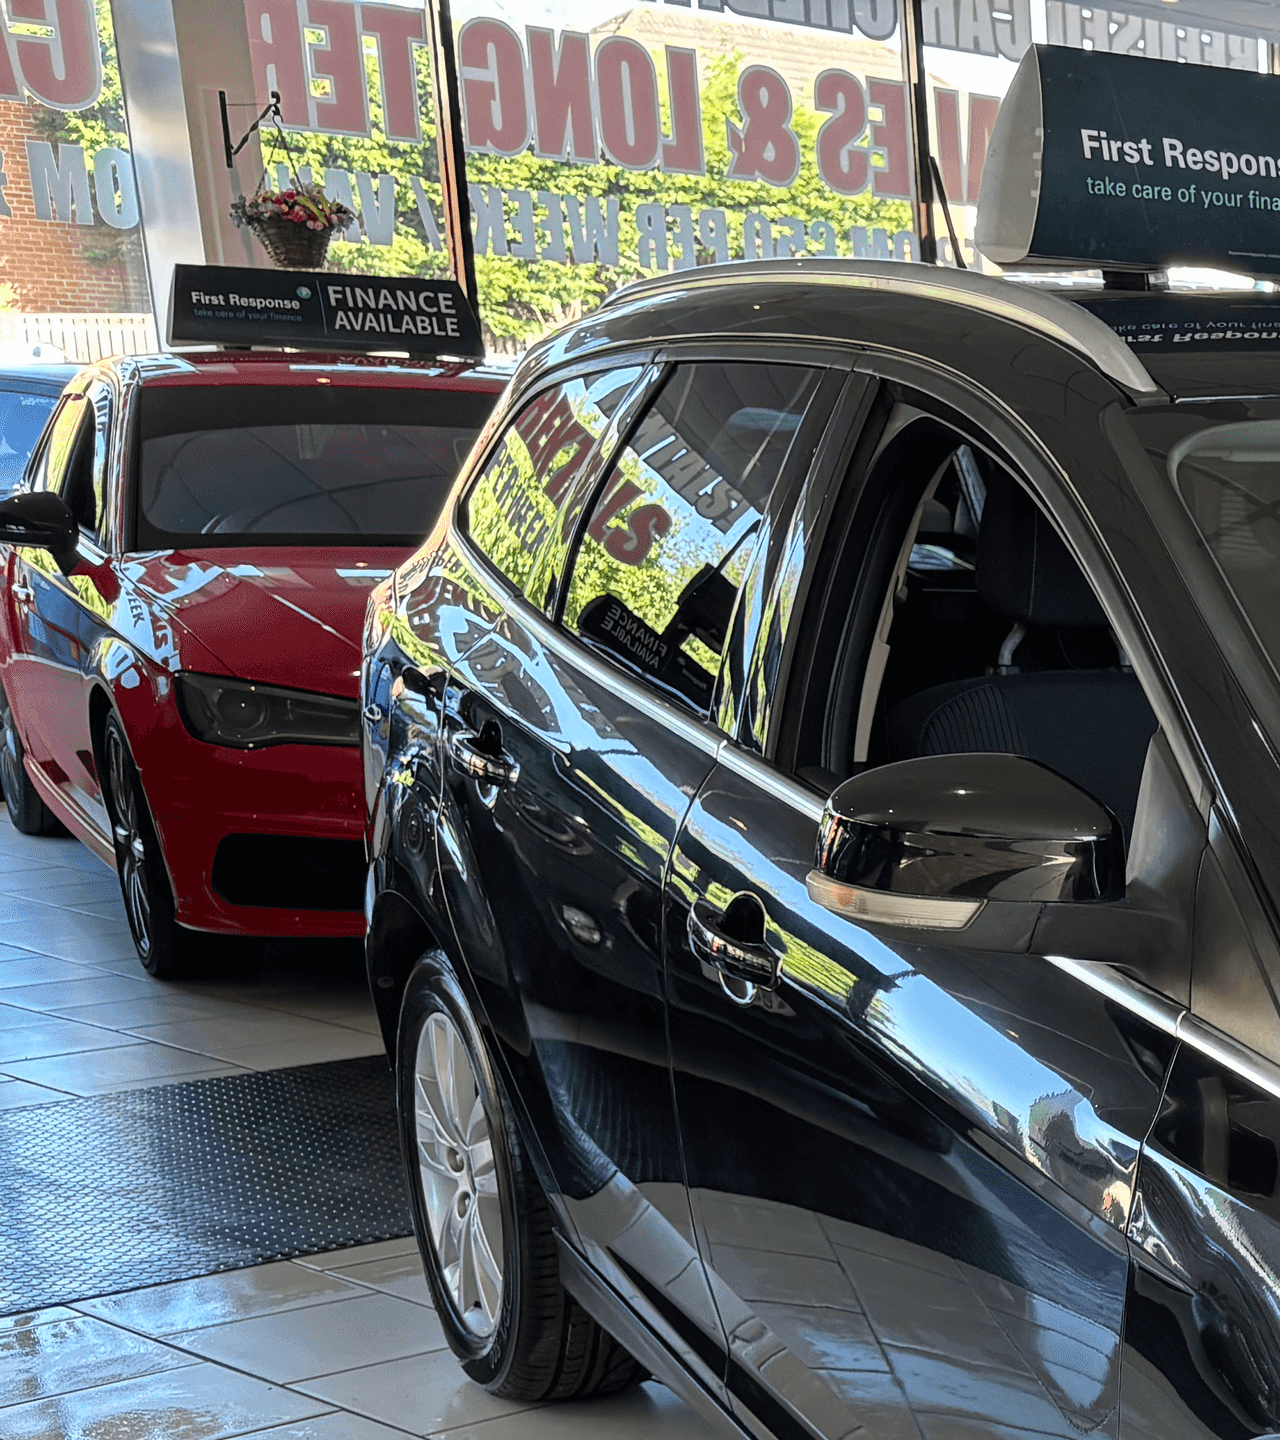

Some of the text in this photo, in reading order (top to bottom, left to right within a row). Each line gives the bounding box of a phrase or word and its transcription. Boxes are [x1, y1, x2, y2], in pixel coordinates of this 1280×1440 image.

[1080, 129, 1154, 166] First
[1086, 176, 1127, 197] take
[1132, 183, 1172, 201] care
[1178, 185, 1197, 203] of
[1201, 191, 1244, 209] your
[191, 291, 300, 310] First Response
[327, 286, 456, 314] FINANCE
[335, 311, 460, 337] AVAILABLE
